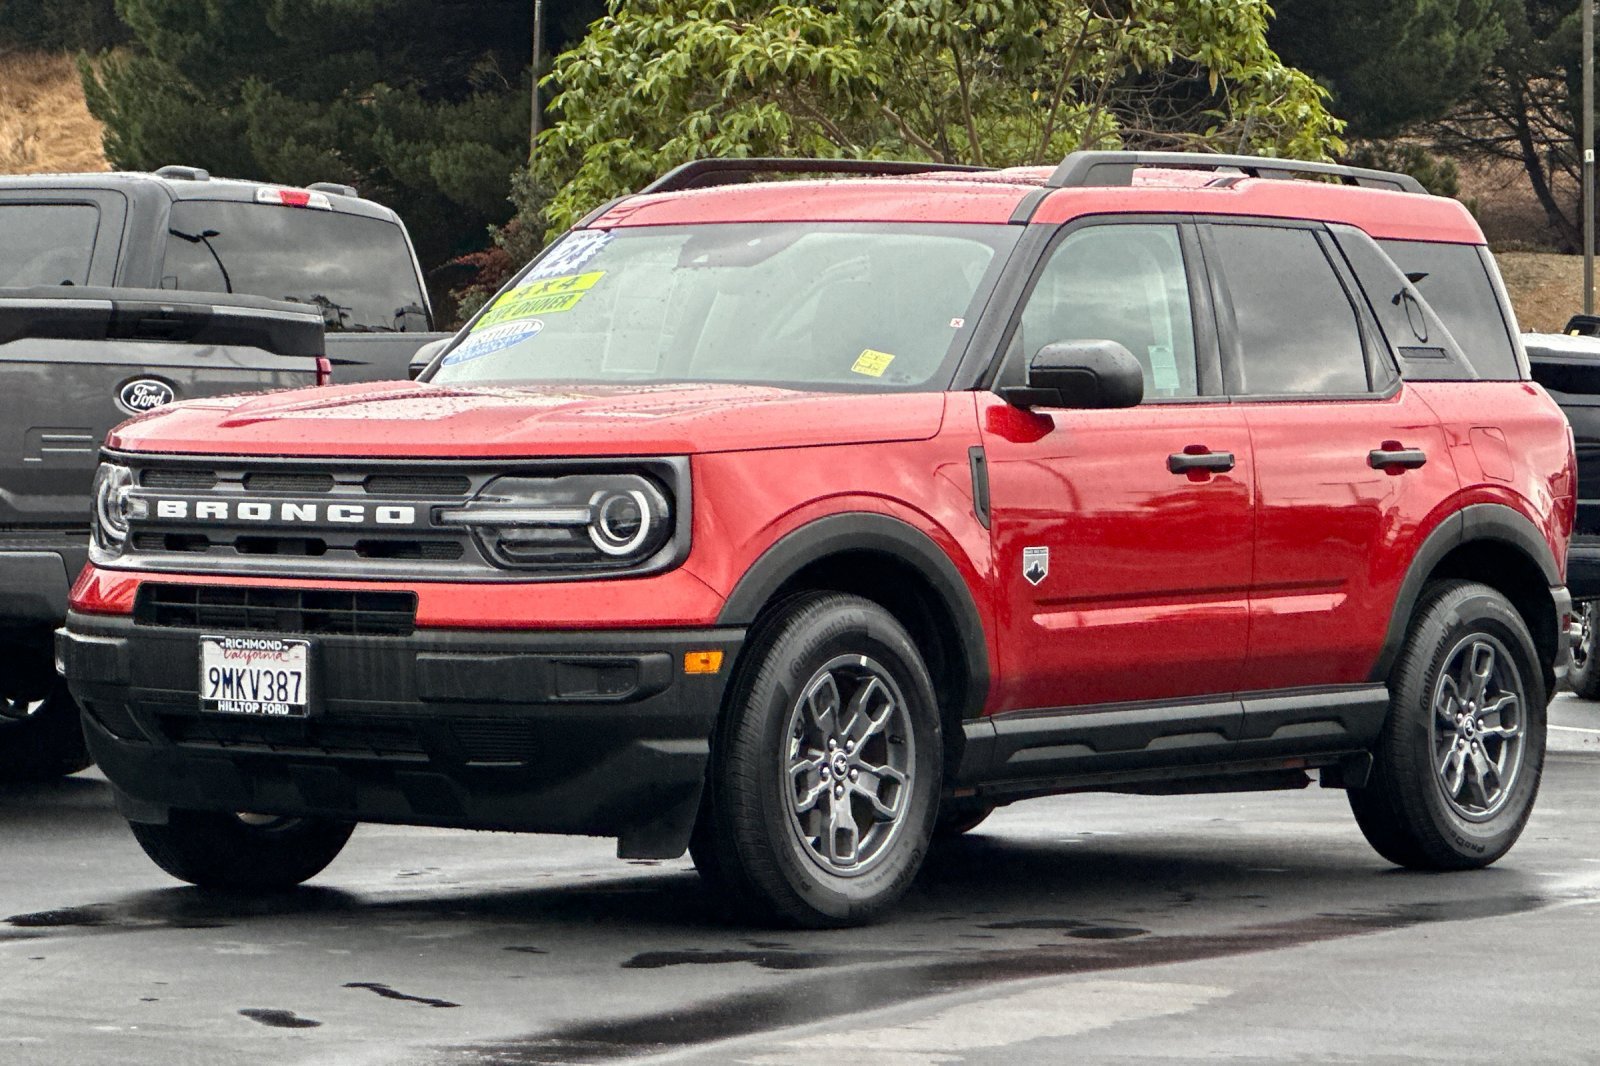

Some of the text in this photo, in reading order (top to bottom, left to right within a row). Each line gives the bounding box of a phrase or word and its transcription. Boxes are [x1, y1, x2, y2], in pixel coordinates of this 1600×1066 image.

[130, 383, 166, 407] Ford
[157, 500, 416, 524] BRONCO
[225, 638, 283, 650] RICHMOND
[223, 649, 289, 665] California
[209, 666, 302, 703] 9MKV387
[217, 700, 289, 715] HILLTOP FORD
